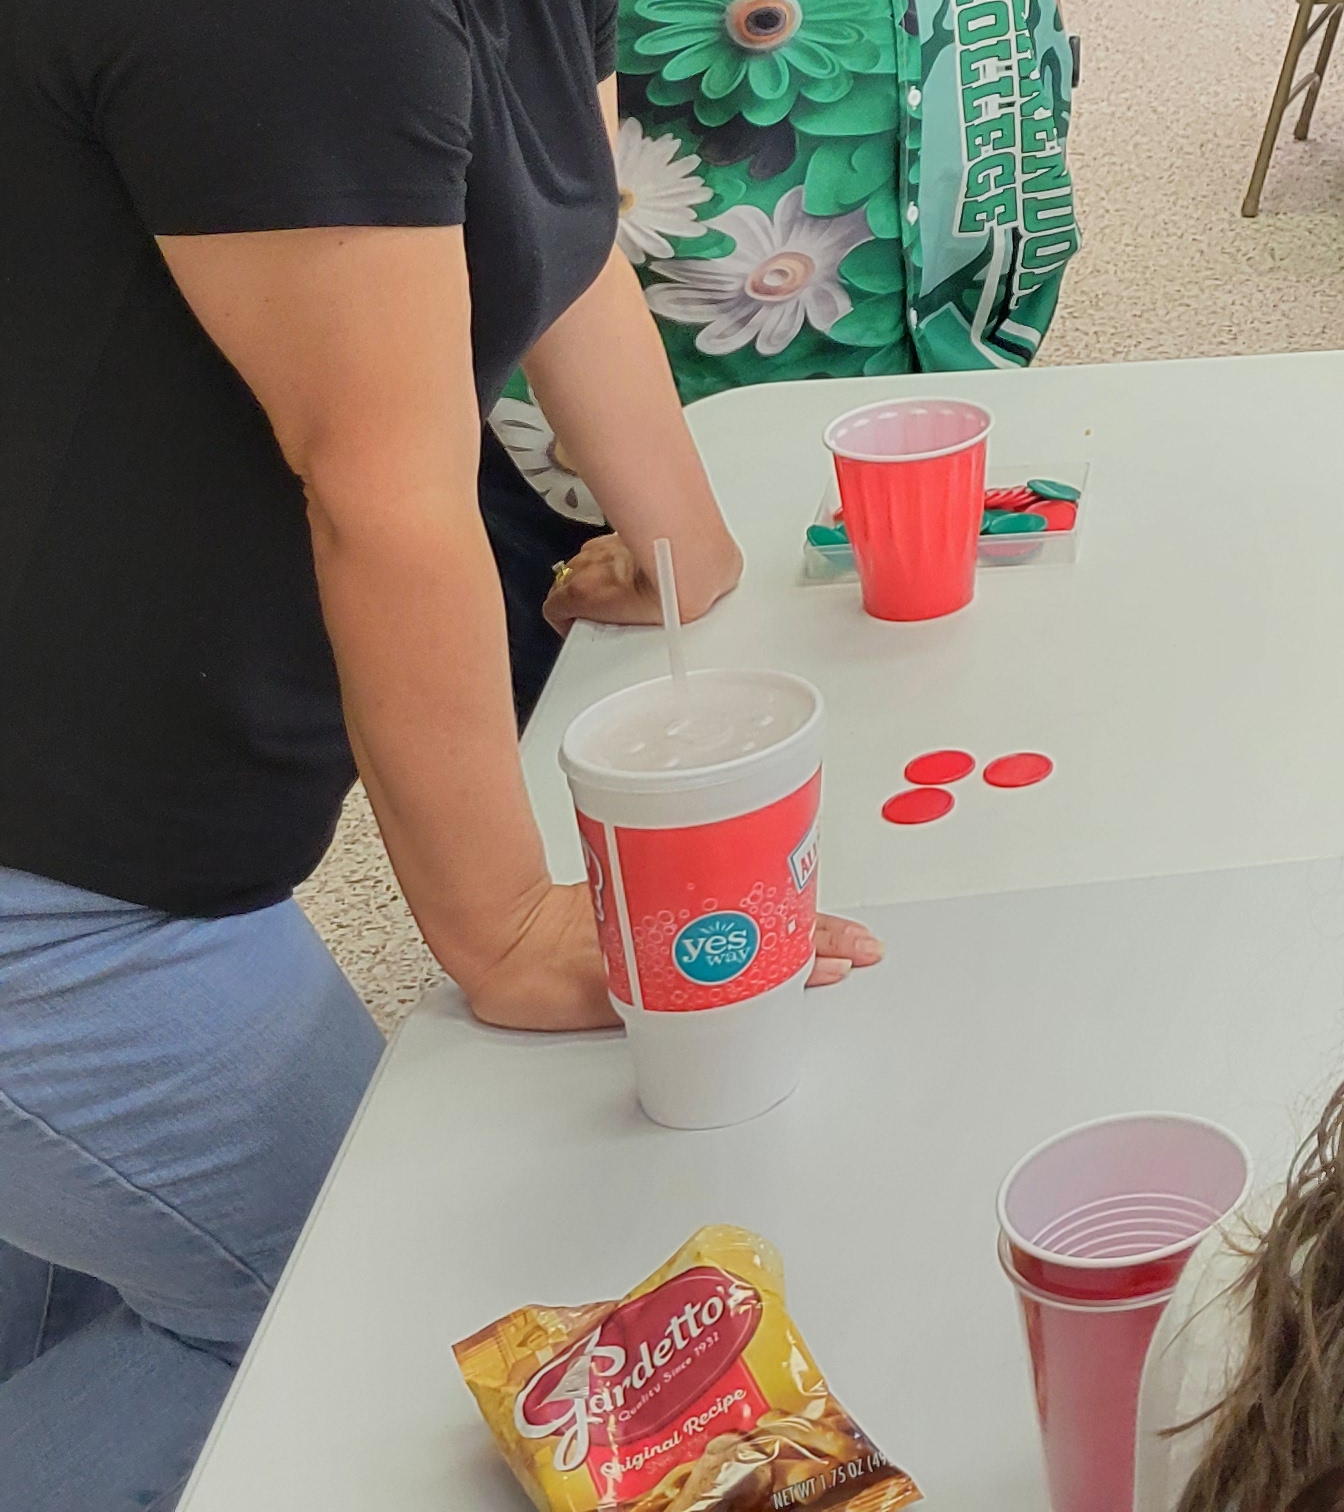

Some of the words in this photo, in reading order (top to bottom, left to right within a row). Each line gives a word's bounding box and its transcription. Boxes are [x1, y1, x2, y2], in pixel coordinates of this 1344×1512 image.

[682, 928, 748, 964] yes
[706, 946, 751, 967] way
[618, 1383, 661, 1422] Quality
[663, 1357, 692, 1383] Since
[693, 1331, 719, 1357] 1932
[600, 1431, 683, 1477] Original
[683, 1388, 747, 1436] Recipe
[772, 1486, 795, 1510] NET
[797, 1478, 816, 1499] WT
[820, 1466, 847, 1490] 1.75
[847, 1458, 865, 1479] OZ
